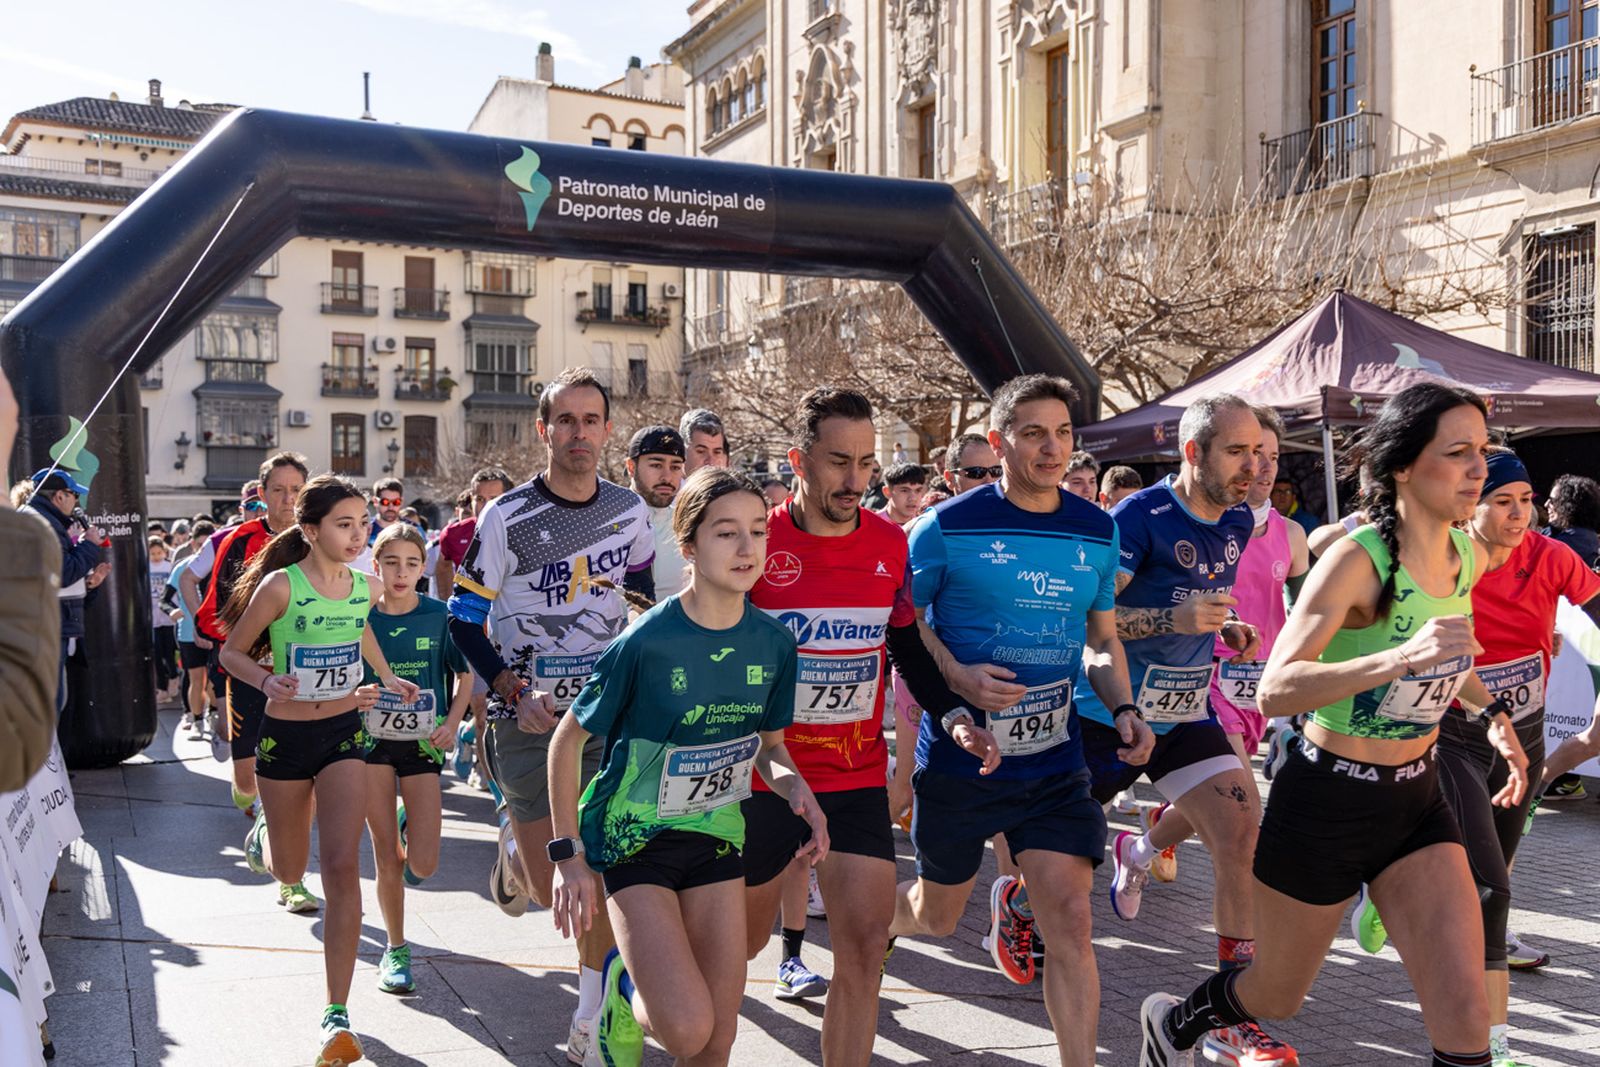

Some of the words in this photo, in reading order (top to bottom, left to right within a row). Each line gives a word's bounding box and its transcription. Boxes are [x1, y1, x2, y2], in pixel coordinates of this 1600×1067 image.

[558, 175, 649, 201] Patronato
[653, 184, 739, 211] Municipal
[743, 195, 766, 211] de
[557, 197, 643, 222] Deportes
[648, 207, 671, 224] de
[675, 208, 719, 229] Jaén
[130, 512, 141, 523] de
[108, 525, 132, 537] Jaén
[303, 656, 325, 667] BUENA
[325, 654, 349, 667] MUERTE
[389, 660, 429, 670] Fundación
[543, 664, 567, 676] BUENA
[567, 663, 592, 676] MUERTE
[810, 660, 842, 669] CARRERA
[314, 666, 348, 689] 715
[800, 670, 827, 682] BUENA
[827, 670, 858, 682] MUERTE
[1496, 673, 1525, 690] MUERTE
[553, 676, 591, 699] 65
[808, 683, 860, 710] 757
[1410, 674, 1459, 708] 747
[1491, 684, 1530, 709] 80
[707, 702, 764, 715] Fundación
[1024, 699, 1052, 716] MUERTE
[1157, 690, 1196, 711] 479
[380, 710, 419, 730] 763
[705, 713, 746, 725] Unicaja
[1008, 712, 1055, 741] 494
[1544, 712, 1588, 727] atronato
[689, 749, 721, 760] CARRERA
[721, 741, 752, 756] CAMINATA
[678, 762, 706, 774] BUENA
[706, 753, 736, 771] MUERTE
[1332, 759, 1380, 782] FILA
[1394, 759, 1427, 783] FILA
[687, 766, 734, 801] 758
